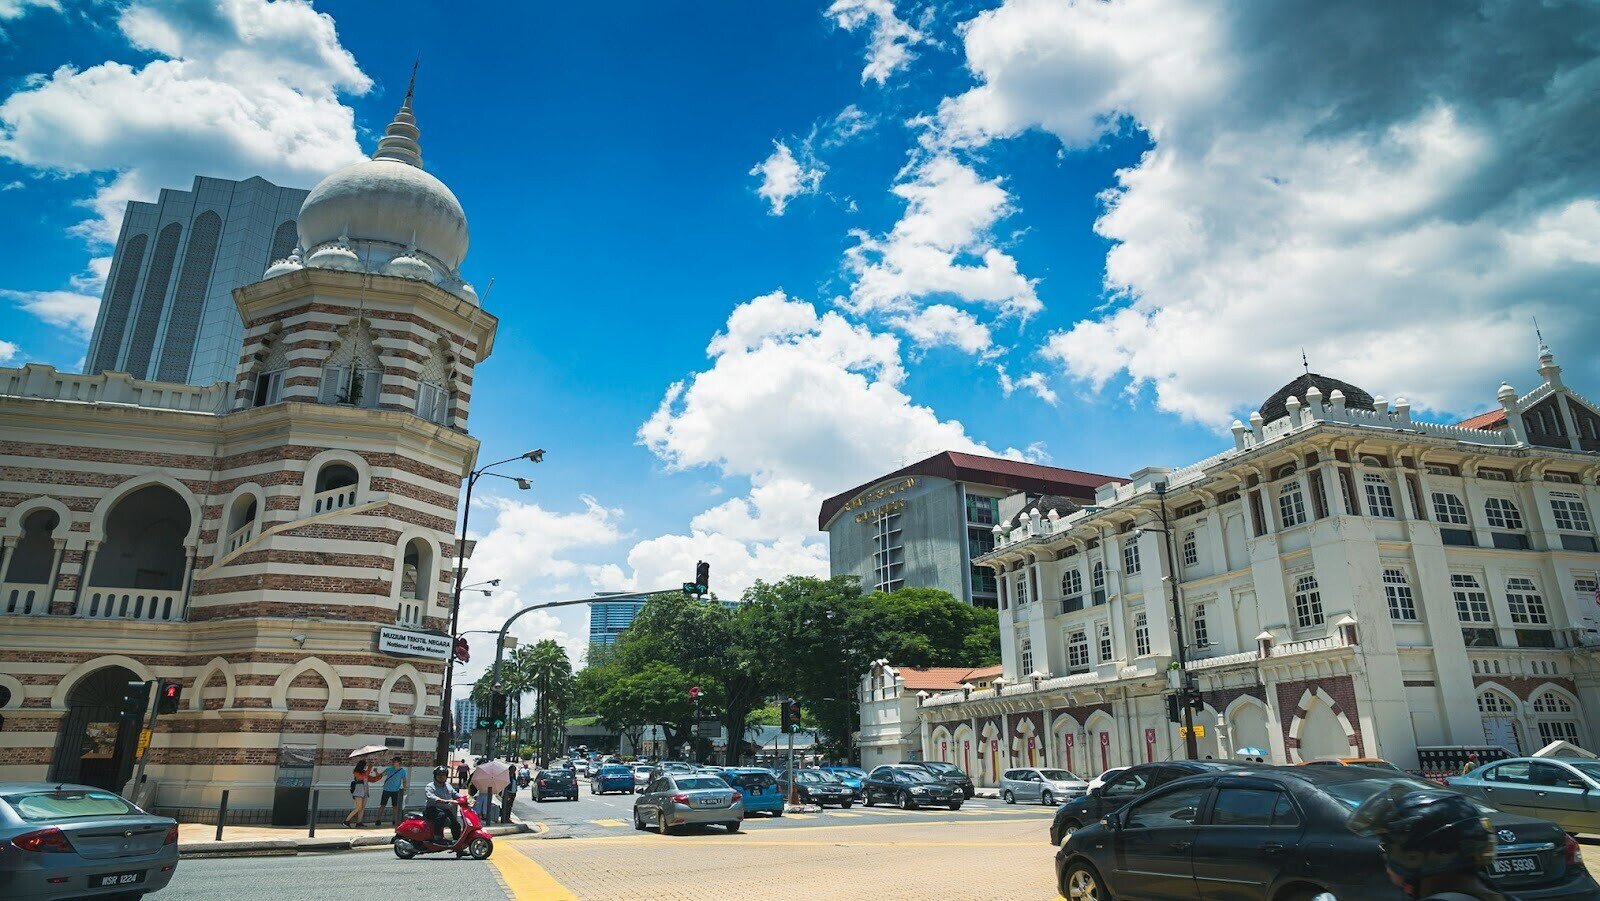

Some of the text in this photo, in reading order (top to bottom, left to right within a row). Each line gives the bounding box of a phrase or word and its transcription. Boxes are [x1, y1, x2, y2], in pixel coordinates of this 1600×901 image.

[382, 632, 450, 648] MUZIUM TEKSTIL NEGARA
[102, 874, 137, 886] WSR 1224
